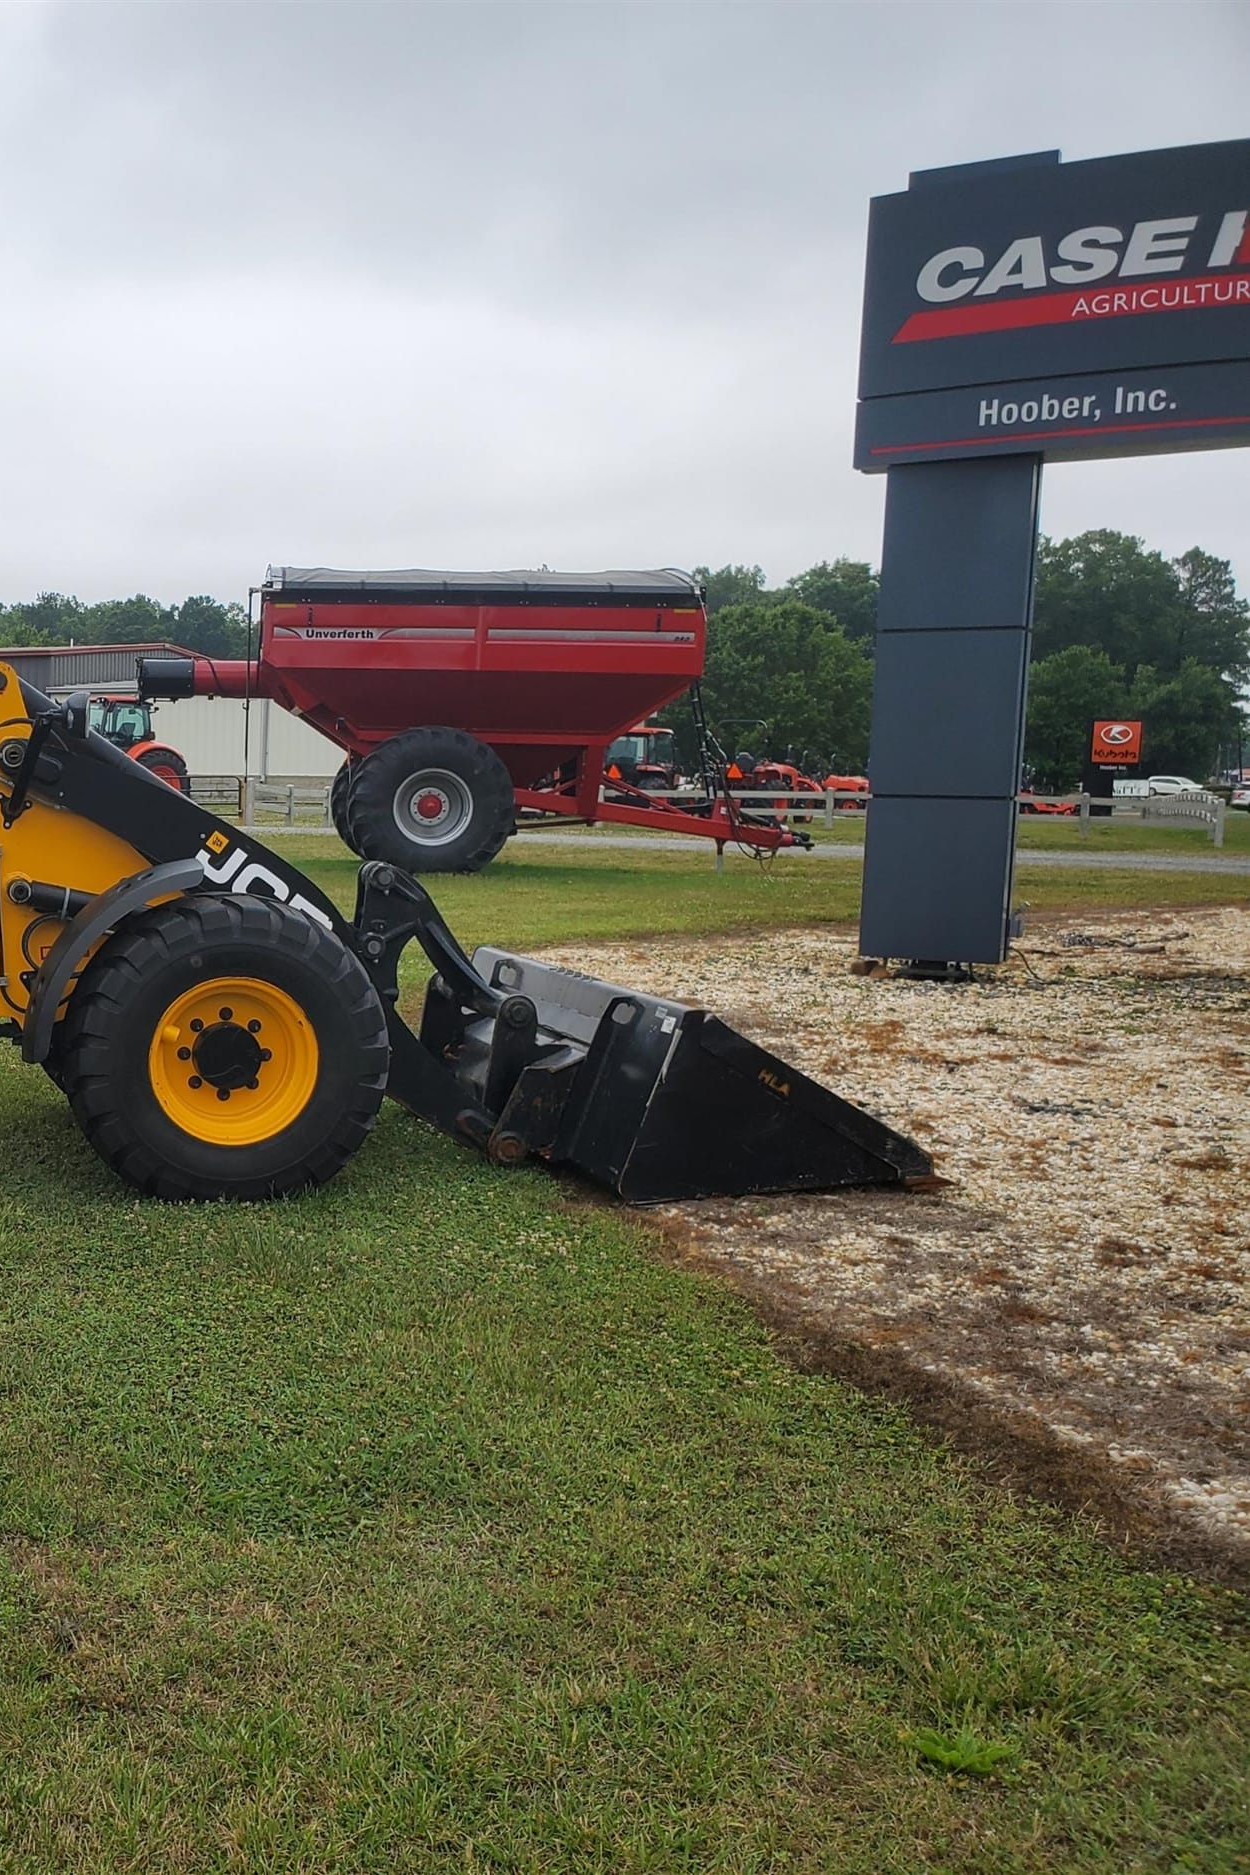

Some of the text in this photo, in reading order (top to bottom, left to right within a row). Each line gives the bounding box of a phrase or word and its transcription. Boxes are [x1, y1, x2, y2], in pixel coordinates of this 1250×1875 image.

[916, 215, 1199, 303] CASE
[978, 386, 1177, 426] Hoober, Inc.
[305, 628, 374, 639] Unverferth
[1093, 748, 1137, 759] Kubota
[758, 1069, 790, 1097] HLA
